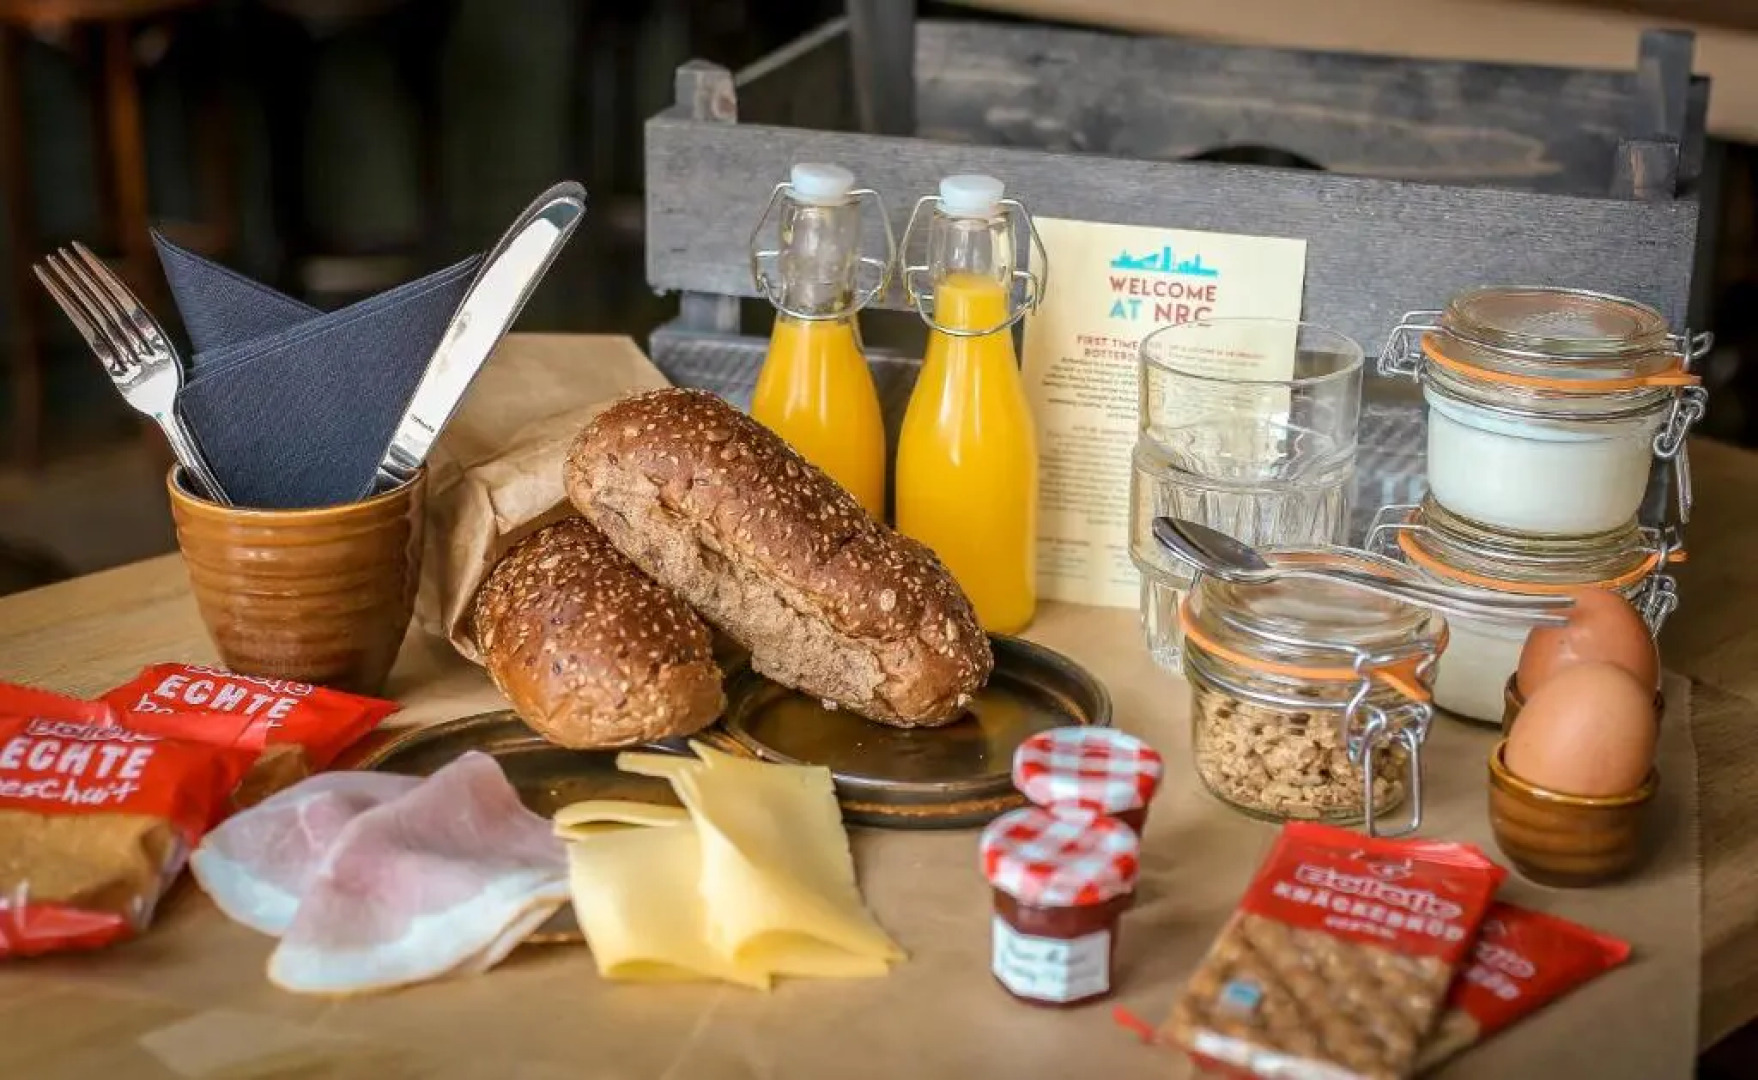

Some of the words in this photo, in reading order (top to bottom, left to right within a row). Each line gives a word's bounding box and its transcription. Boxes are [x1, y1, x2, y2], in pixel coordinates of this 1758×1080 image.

[1109, 275, 1217, 302] WELCOME
[1109, 299, 1142, 320] AT
[1077, 335, 1107, 346] FIRST
[1112, 339, 1138, 350] TIME
[154, 674, 299, 719] ECHTE
[0, 736, 154, 779] ECHTE
[0, 778, 140, 805] eschuit
